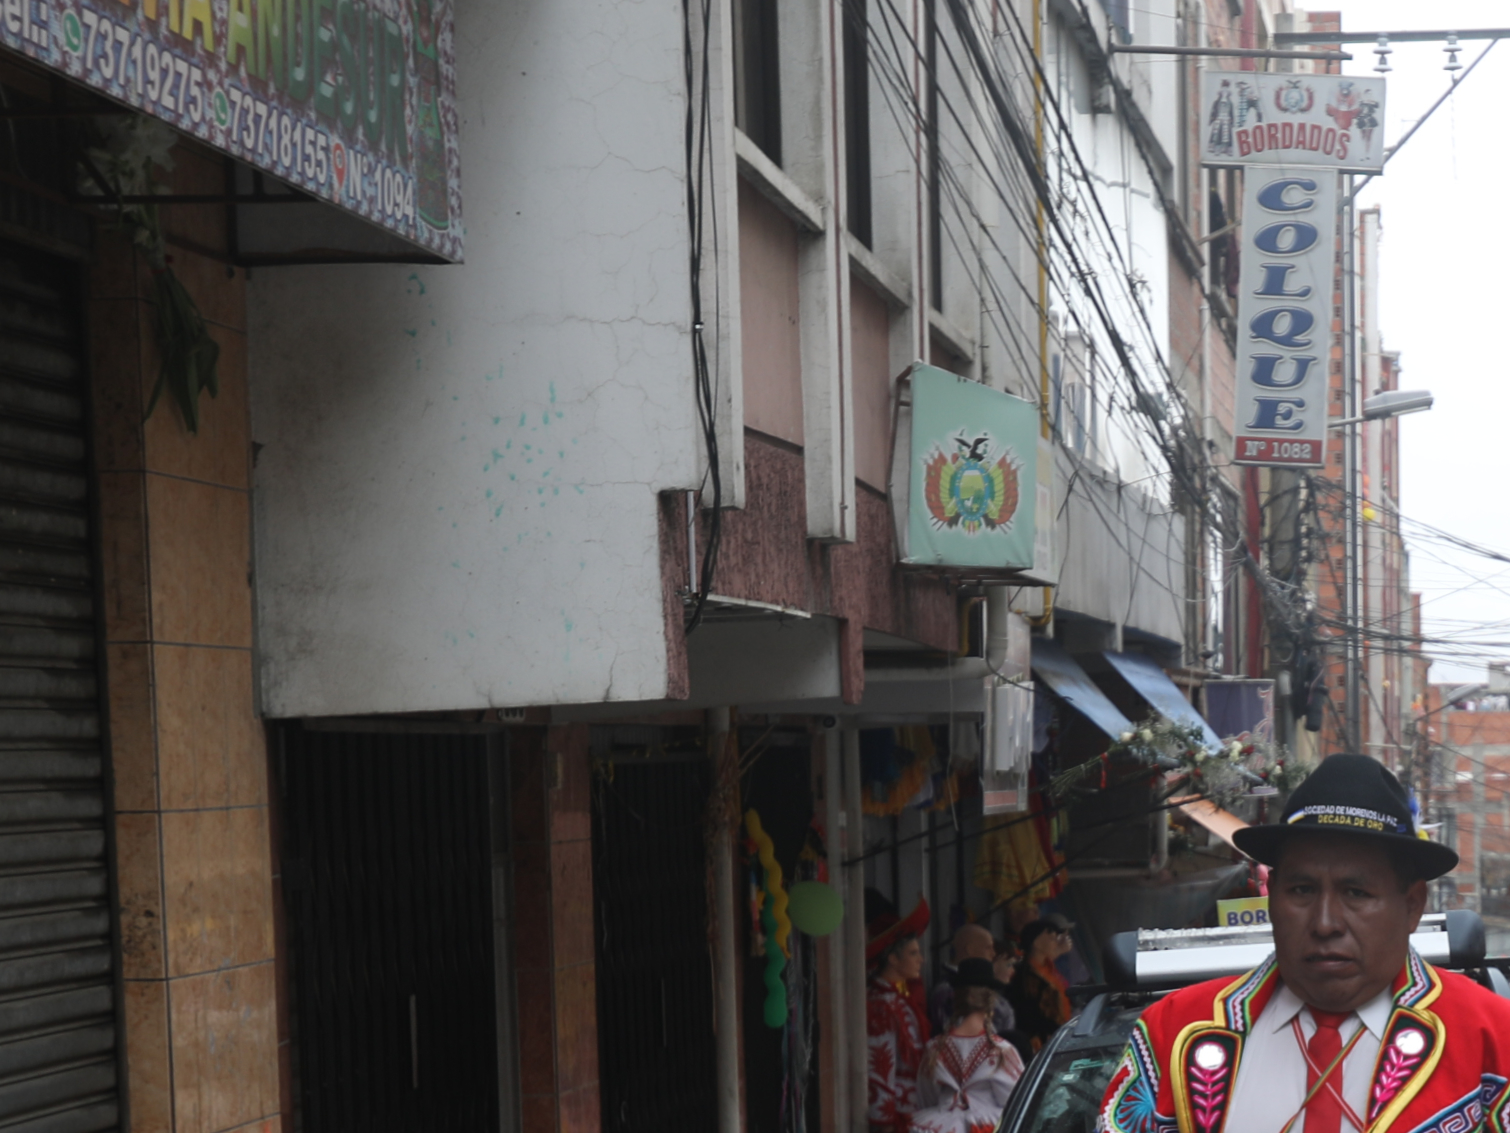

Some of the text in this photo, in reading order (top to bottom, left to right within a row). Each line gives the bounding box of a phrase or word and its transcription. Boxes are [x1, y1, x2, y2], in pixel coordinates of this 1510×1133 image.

[83, 8, 201, 122] 73719275
[229, 88, 327, 185] 73718155
[374, 162, 415, 225] 1094
[1236, 121, 1351, 160] BORDADOS
[1245, 176, 1319, 432] COLQUE
[1272, 442, 1312, 459] 1082
[1318, 814, 1384, 831] DECADA DE ORO
